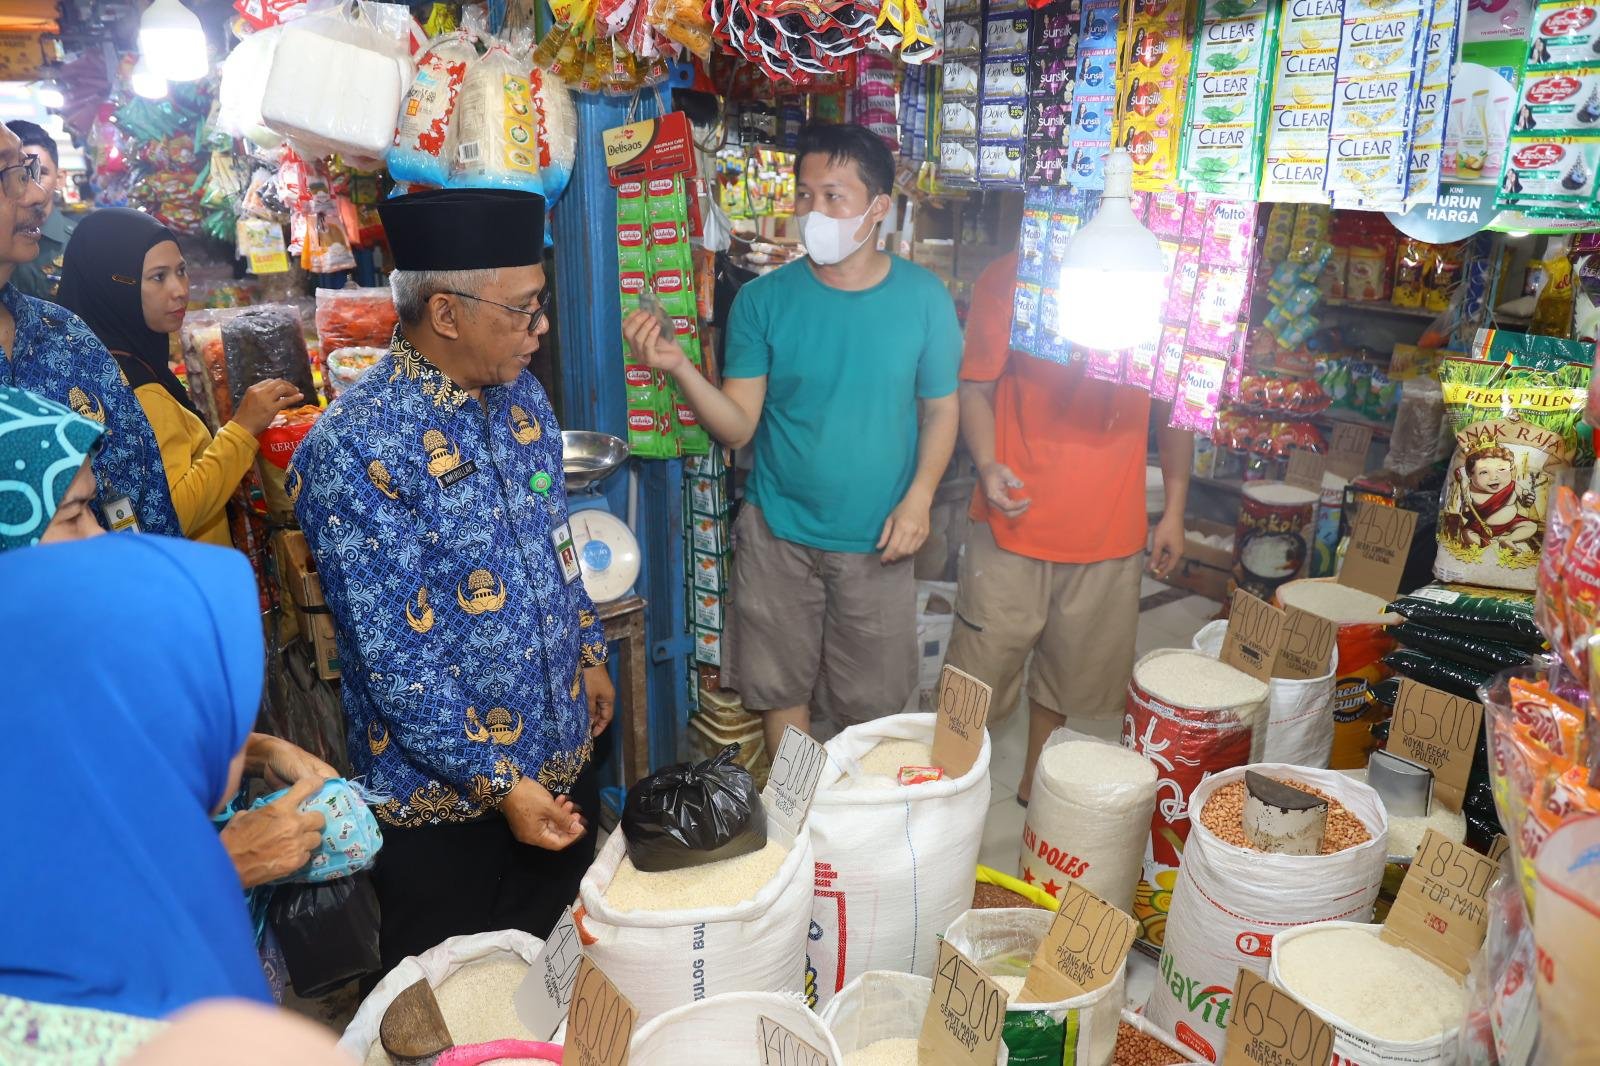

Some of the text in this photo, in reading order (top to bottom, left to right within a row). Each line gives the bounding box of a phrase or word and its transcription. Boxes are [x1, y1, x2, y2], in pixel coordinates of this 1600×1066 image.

[1293, 0, 1344, 18] CLEAR
[945, 24, 964, 36] Dove
[988, 23, 1012, 35] Dove
[1043, 24, 1072, 38] sunsilk
[1208, 22, 1255, 41] CLEAR
[1350, 21, 1406, 42] CLEAR
[1135, 41, 1168, 56] sunsilk
[944, 66, 962, 77] Dove
[987, 66, 1009, 78] Dove
[1286, 56, 1338, 72] CLEAR
[1040, 70, 1070, 84] sunsilk
[1084, 70, 1104, 80] sunsilk
[1204, 76, 1248, 94] CLEAR
[1344, 82, 1398, 100] CLEAR
[1131, 92, 1164, 106] sunsilk
[943, 107, 962, 117] Dove
[984, 106, 1007, 119] Dove
[1038, 114, 1066, 126] sunsilk
[1278, 110, 1330, 128] CLEAR
[1079, 116, 1100, 126] sunsilk
[1198, 129, 1244, 145] CLEAR
[608, 140, 642, 156] Delisaos
[942, 146, 960, 157] Dove
[982, 148, 1004, 160] Dove
[1127, 142, 1158, 155] sunsilk
[1338, 139, 1392, 156] CLEAR
[1518, 148, 1561, 162] Lifebuoy
[1036, 158, 1064, 170] sunsilk
[1076, 162, 1096, 172] sunsilk
[1272, 164, 1322, 180] CLEAR
[650, 180, 672, 189] Ladaku
[1214, 204, 1246, 220] Molto
[1427, 208, 1478, 224] HARGA
[620, 231, 640, 240] Ladaku
[654, 229, 675, 238] Ladaku
[1024, 228, 1040, 241] Molto
[622, 278, 642, 288] Ladaku
[658, 276, 679, 286] Ladaku
[1016, 298, 1036, 312] Molto
[672, 318, 687, 328] daku
[1186, 372, 1214, 390] Molto
[1465, 390, 1514, 405] BERAS
[1518, 393, 1574, 408] PULEN
[1456, 424, 1561, 453] ANAK RAJA
[444, 462, 474, 485] AMIRULLAH
[1352, 503, 1412, 551] 14500
[1229, 590, 1280, 650] 14000
[938, 668, 988, 730] 16000
[1392, 680, 1476, 751] 16500
[1402, 734, 1451, 762] ROYAL REGAL
[769, 726, 824, 802] 15000
[1410, 750, 1444, 770] (PULEN)
[1038, 840, 1090, 880] POLES
[1421, 876, 1450, 904] TOP
[1450, 894, 1484, 925] MAN
[693, 922, 706, 950] BUL
[1048, 881, 1129, 975] 14500
[1245, 938, 1252, 950] 1
[1056, 945, 1096, 980] PISANG MAS
[1057, 960, 1086, 986] (PULEN)
[932, 940, 999, 1042] 14500
[567, 956, 632, 1066] 16000
[1230, 968, 1332, 1066] 16500
[940, 1002, 980, 1046] SEMUT MADU
[944, 1018, 974, 1053] (PULEN)
[1252, 1036, 1282, 1063] BERAS
